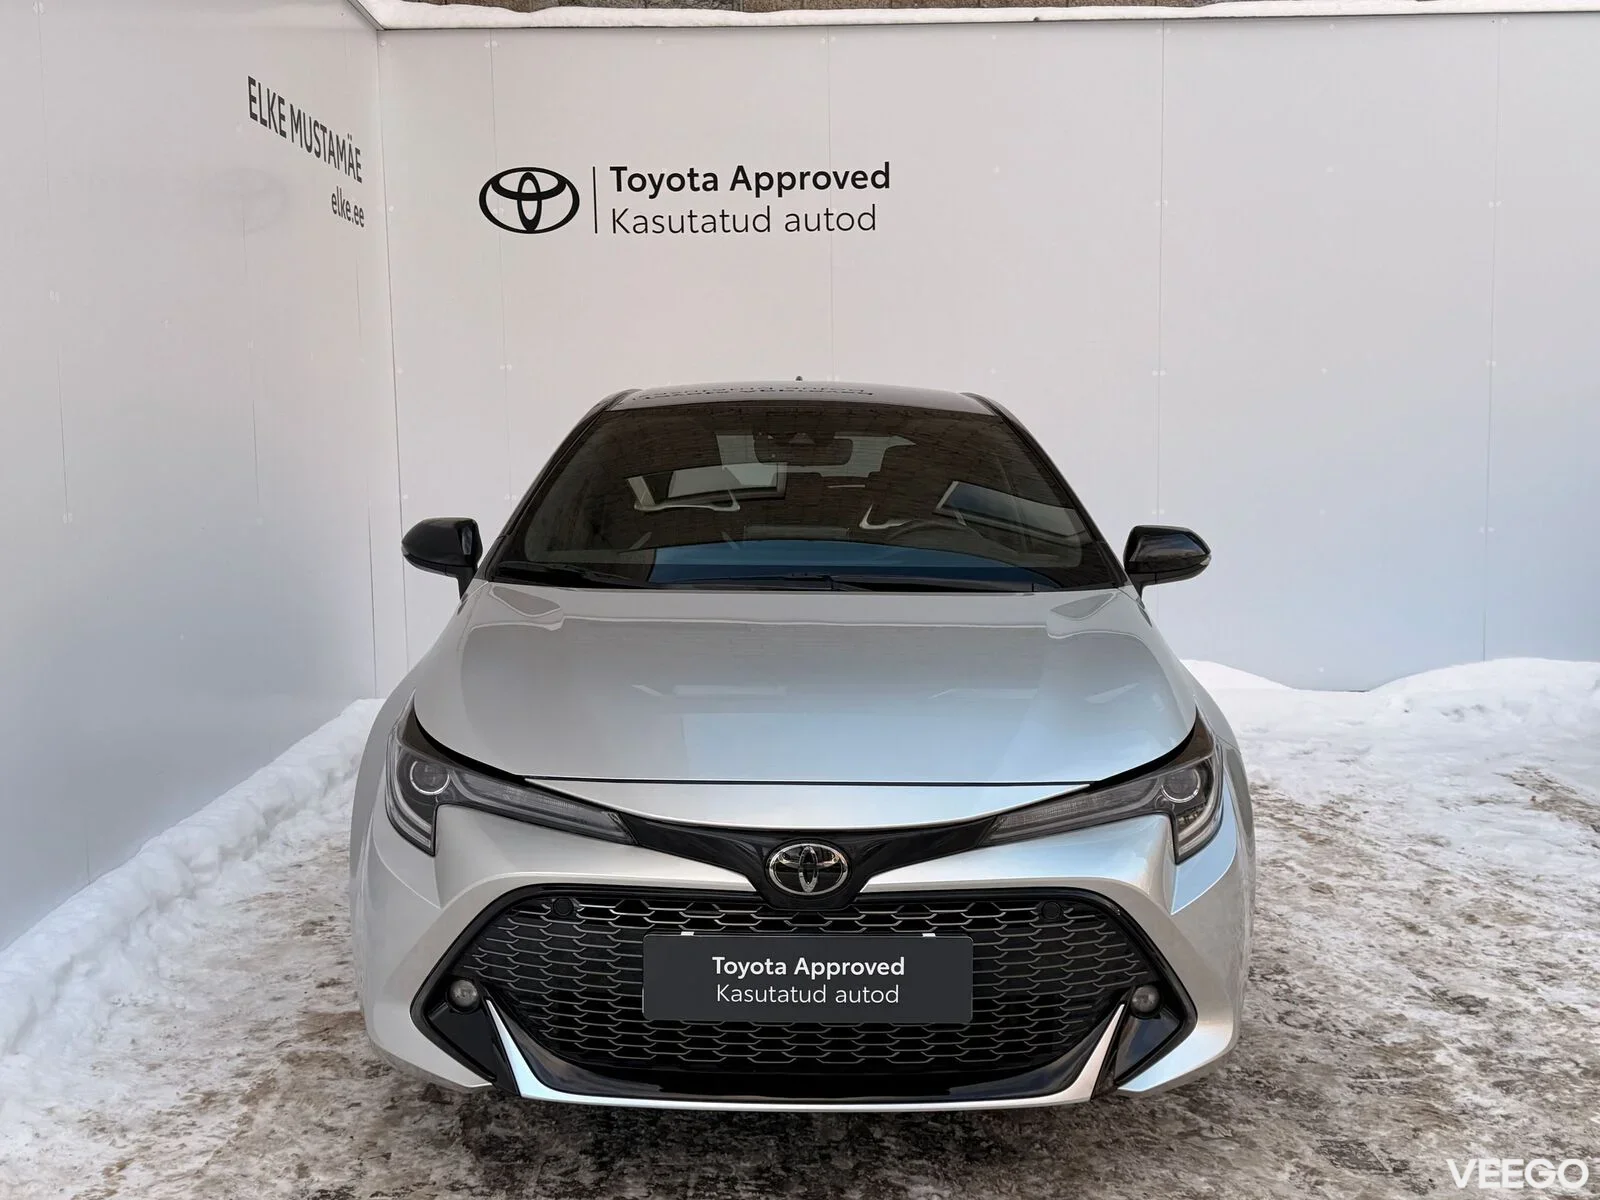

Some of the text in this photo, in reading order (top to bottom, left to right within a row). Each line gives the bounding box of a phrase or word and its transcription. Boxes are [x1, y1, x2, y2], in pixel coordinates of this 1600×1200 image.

[248, 75, 362, 183] ELKE MUSTAMÄE
[609, 162, 891, 199] Toyota Approved
[331, 186, 365, 227] elke.ee
[612, 204, 876, 234] Kasutatud autod
[712, 957, 905, 980] Toyota Approved
[717, 984, 899, 1003] Kasutatud autod
